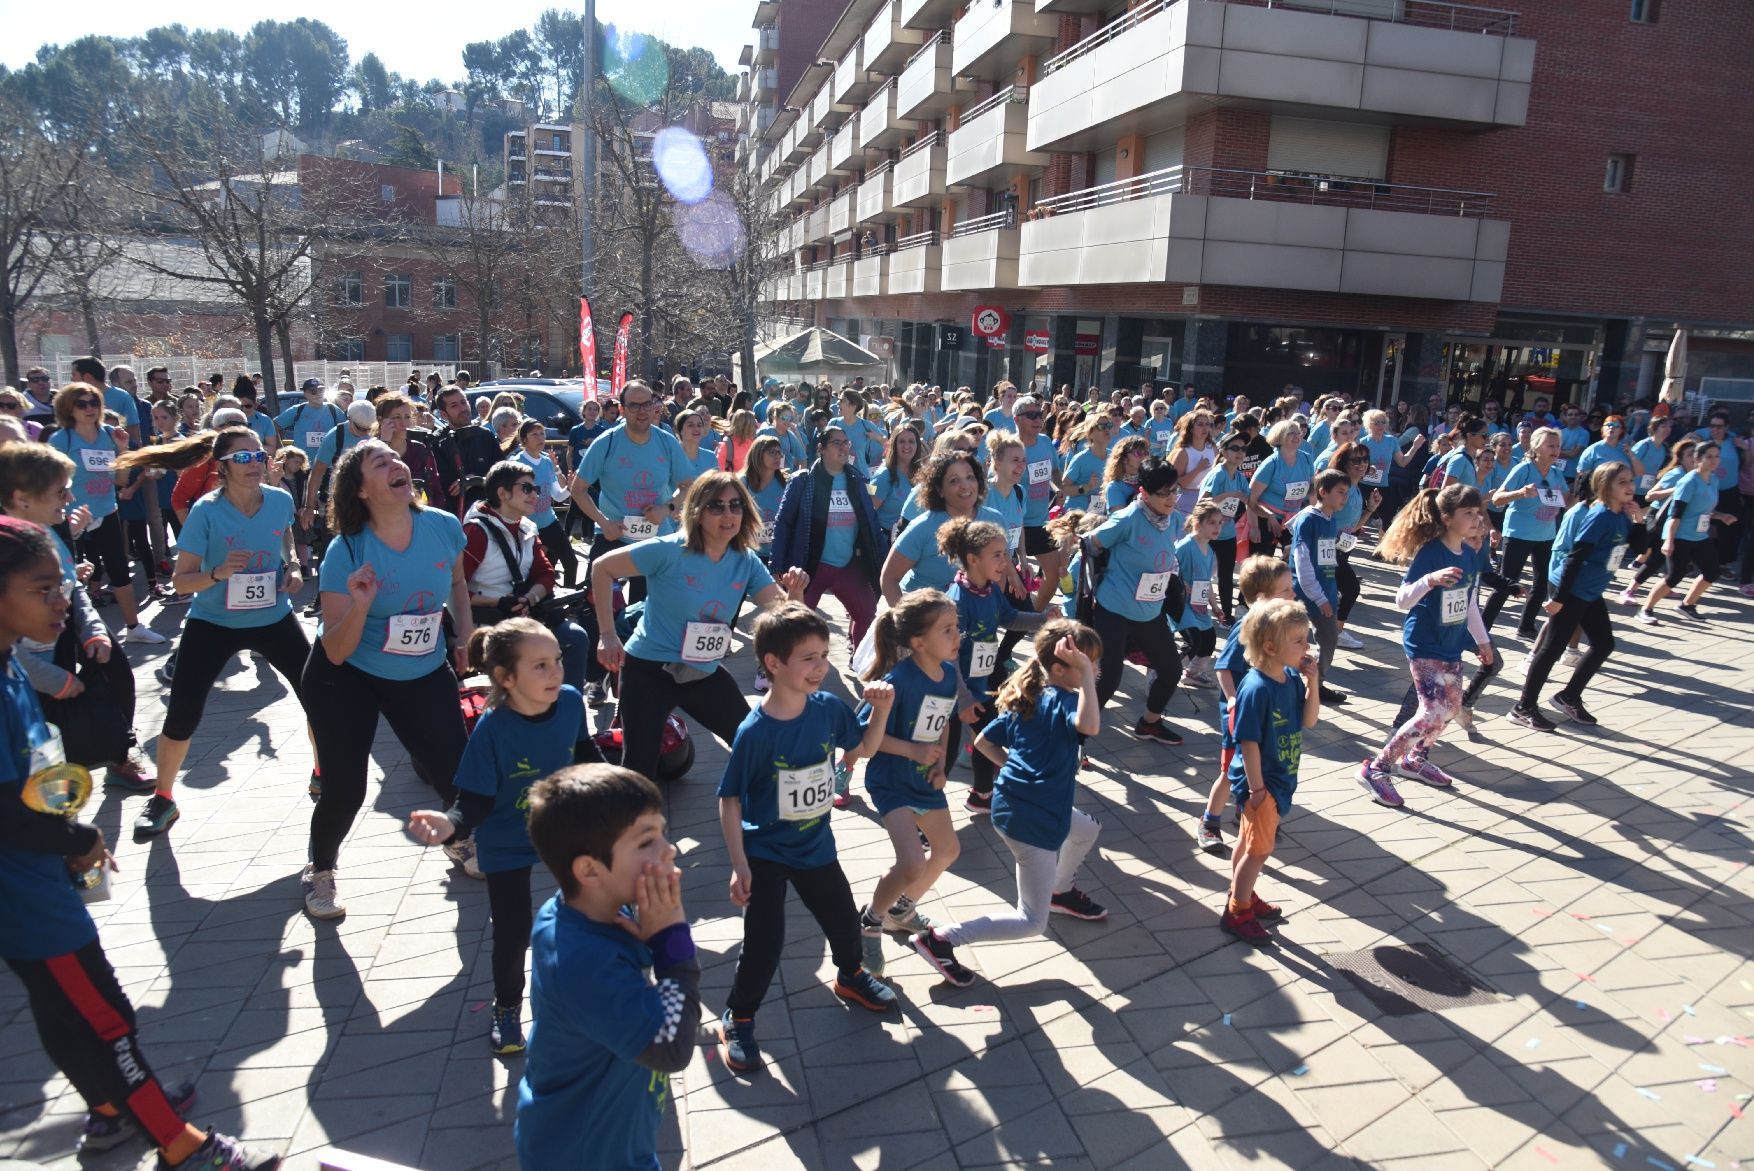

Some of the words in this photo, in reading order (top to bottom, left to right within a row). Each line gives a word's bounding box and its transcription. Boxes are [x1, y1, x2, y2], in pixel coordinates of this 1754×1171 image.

[89, 456, 109, 466] 696
[1034, 467, 1048, 478] 693
[1291, 487, 1305, 495] 229
[1222, 502, 1236, 512] 245
[630, 524, 652, 535] 548
[245, 585, 265, 600] 53
[400, 627, 431, 645] 576
[696, 636, 724, 651] 588
[788, 777, 833, 807] 1052
